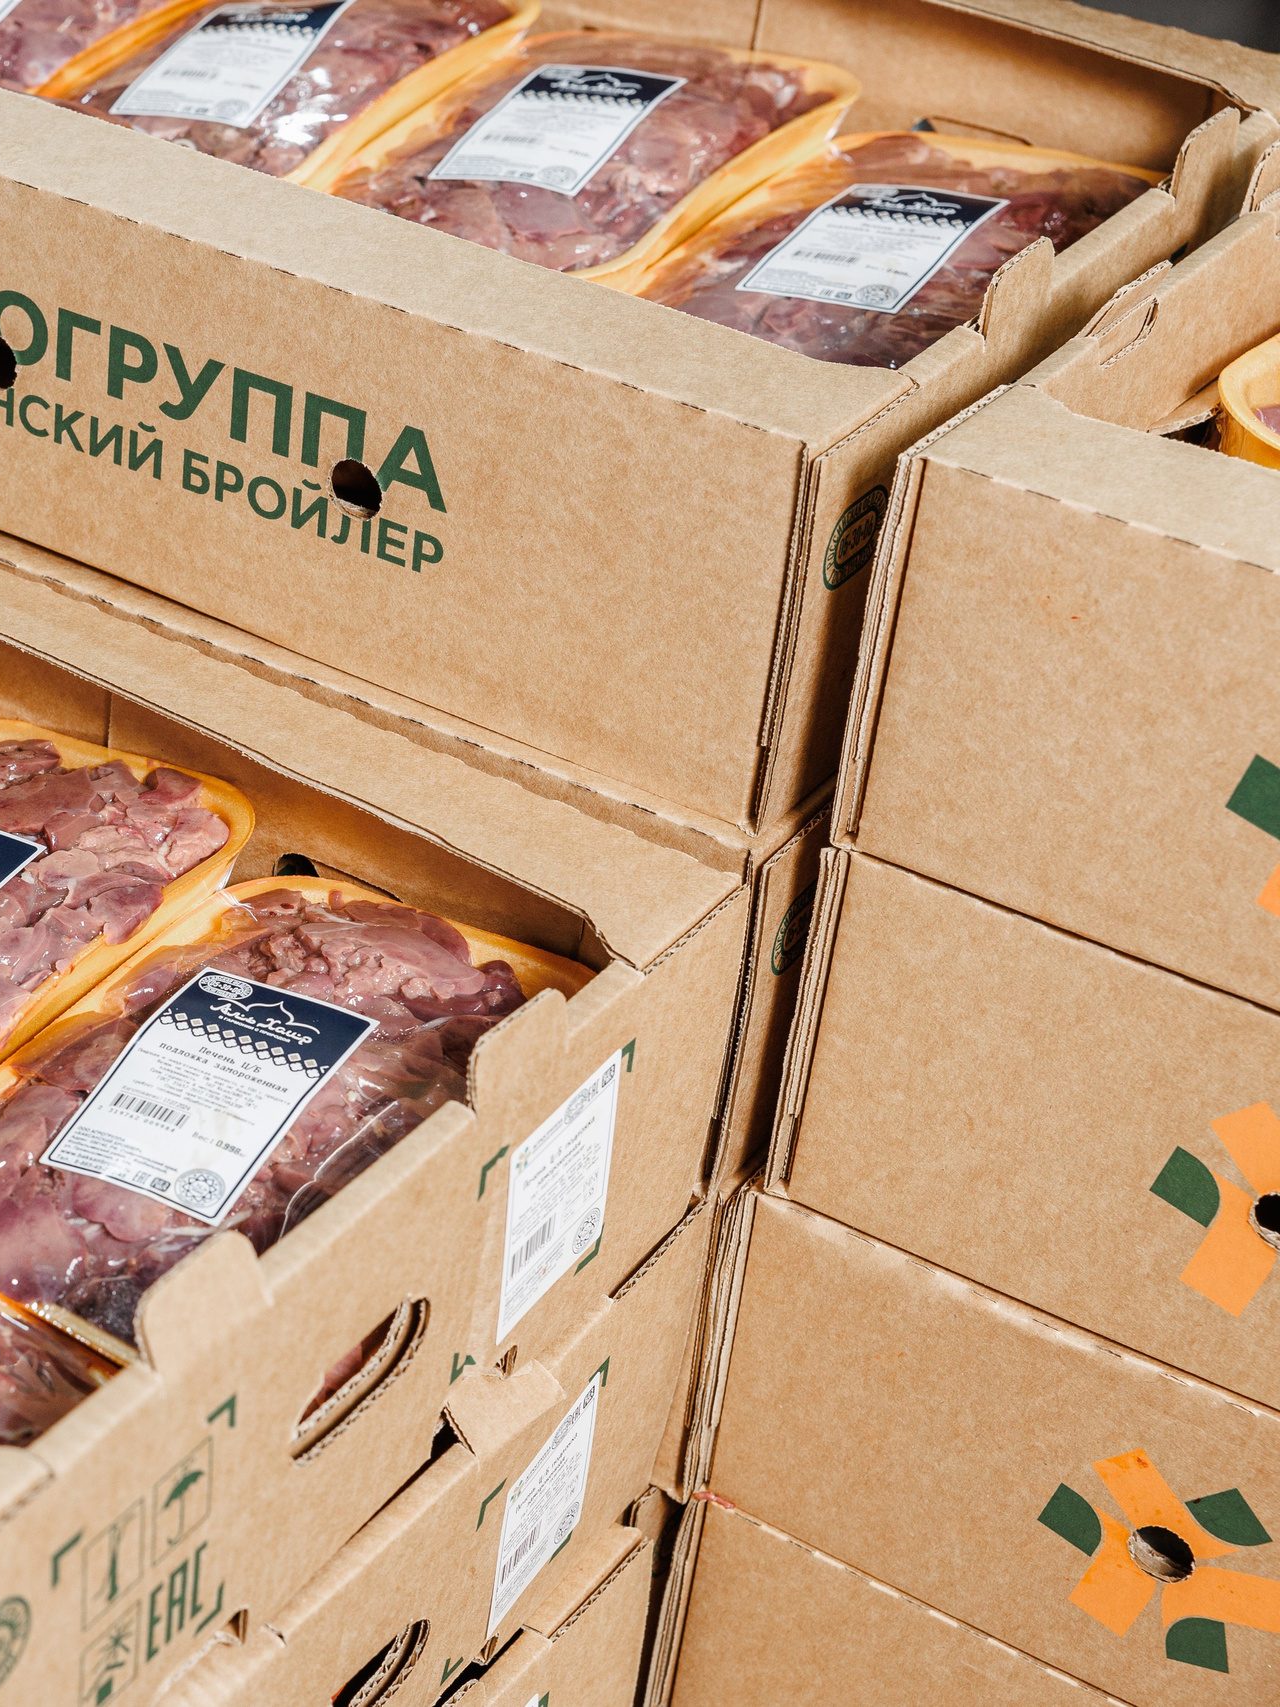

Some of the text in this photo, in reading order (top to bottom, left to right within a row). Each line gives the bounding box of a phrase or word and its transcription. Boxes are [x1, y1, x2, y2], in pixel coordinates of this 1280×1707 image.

[182, 449, 445, 573] БРОЙЛЕР
[210, 1002, 312, 1046] Аль Хаир
[159, 1043, 288, 1093] подложка замороженная
[199, 1047, 261, 1073] Печень Ц/Б
[147, 1541, 208, 1663] EAC
